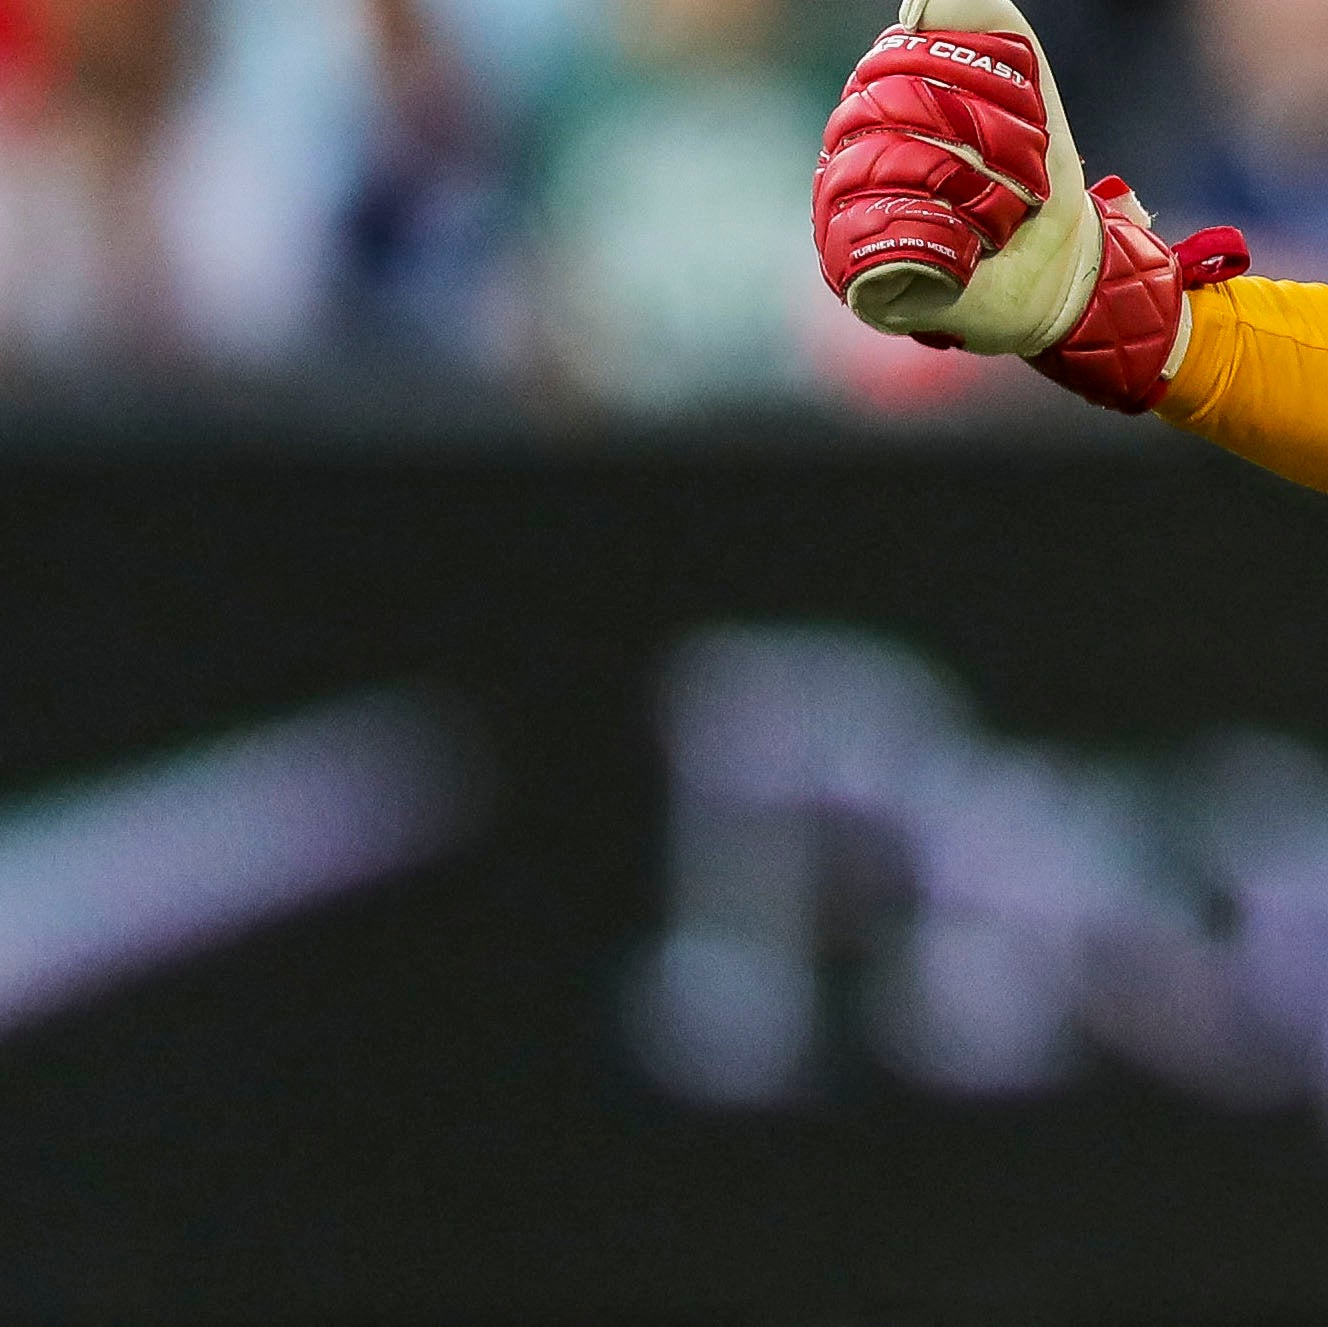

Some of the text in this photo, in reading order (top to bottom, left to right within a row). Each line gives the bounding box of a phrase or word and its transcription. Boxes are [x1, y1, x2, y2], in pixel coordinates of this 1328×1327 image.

[929, 40, 1027, 84] COAST
[852, 237, 957, 260] TURNER PRO MODEL
